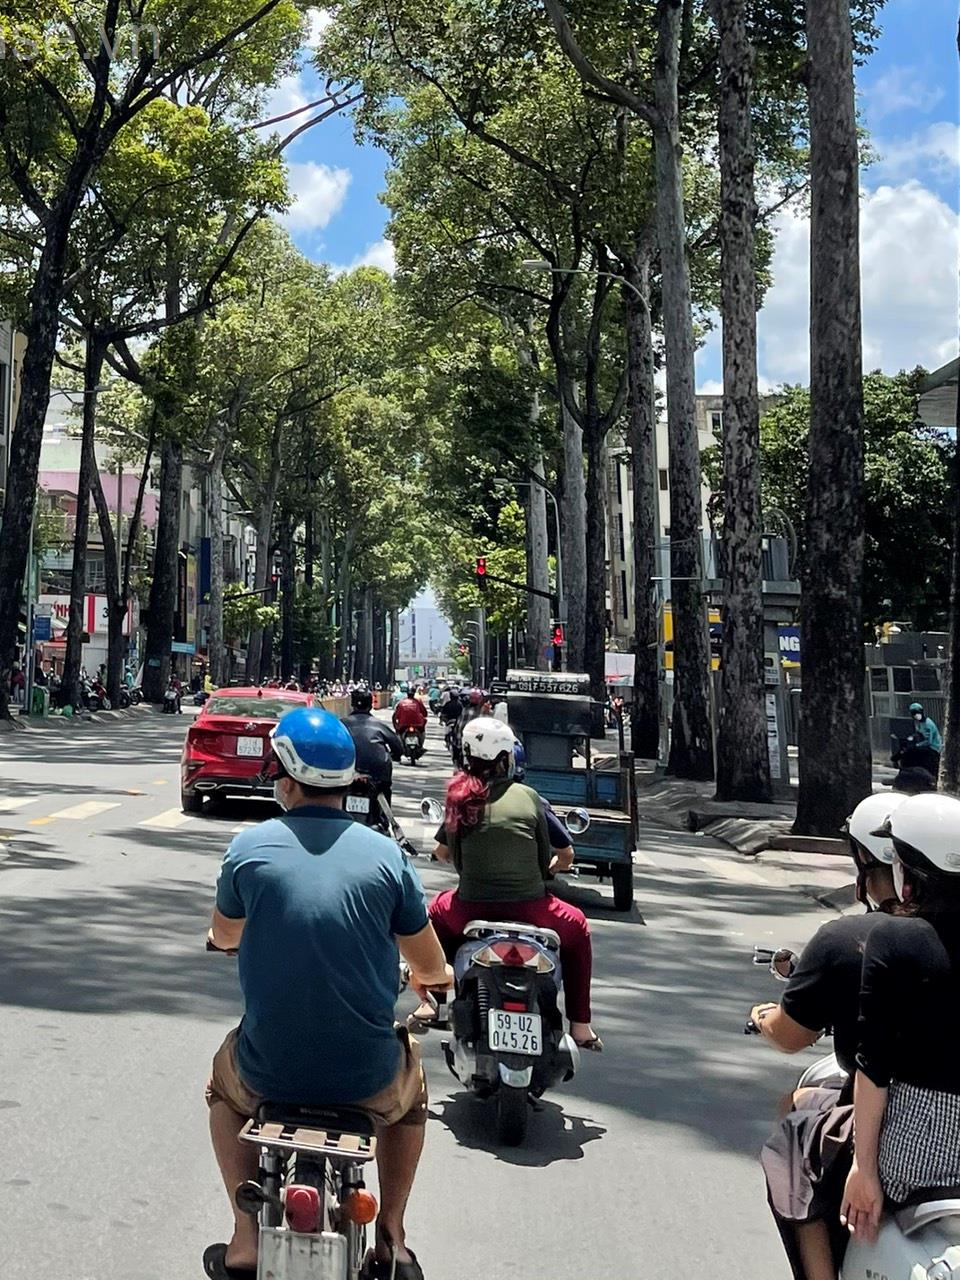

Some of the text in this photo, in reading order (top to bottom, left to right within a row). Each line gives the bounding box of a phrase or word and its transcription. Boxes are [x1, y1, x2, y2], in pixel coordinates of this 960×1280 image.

[779, 635, 800, 651] NG
[497, 1013, 533, 1033] 59-U2
[493, 1030, 538, 1051] 045.26
